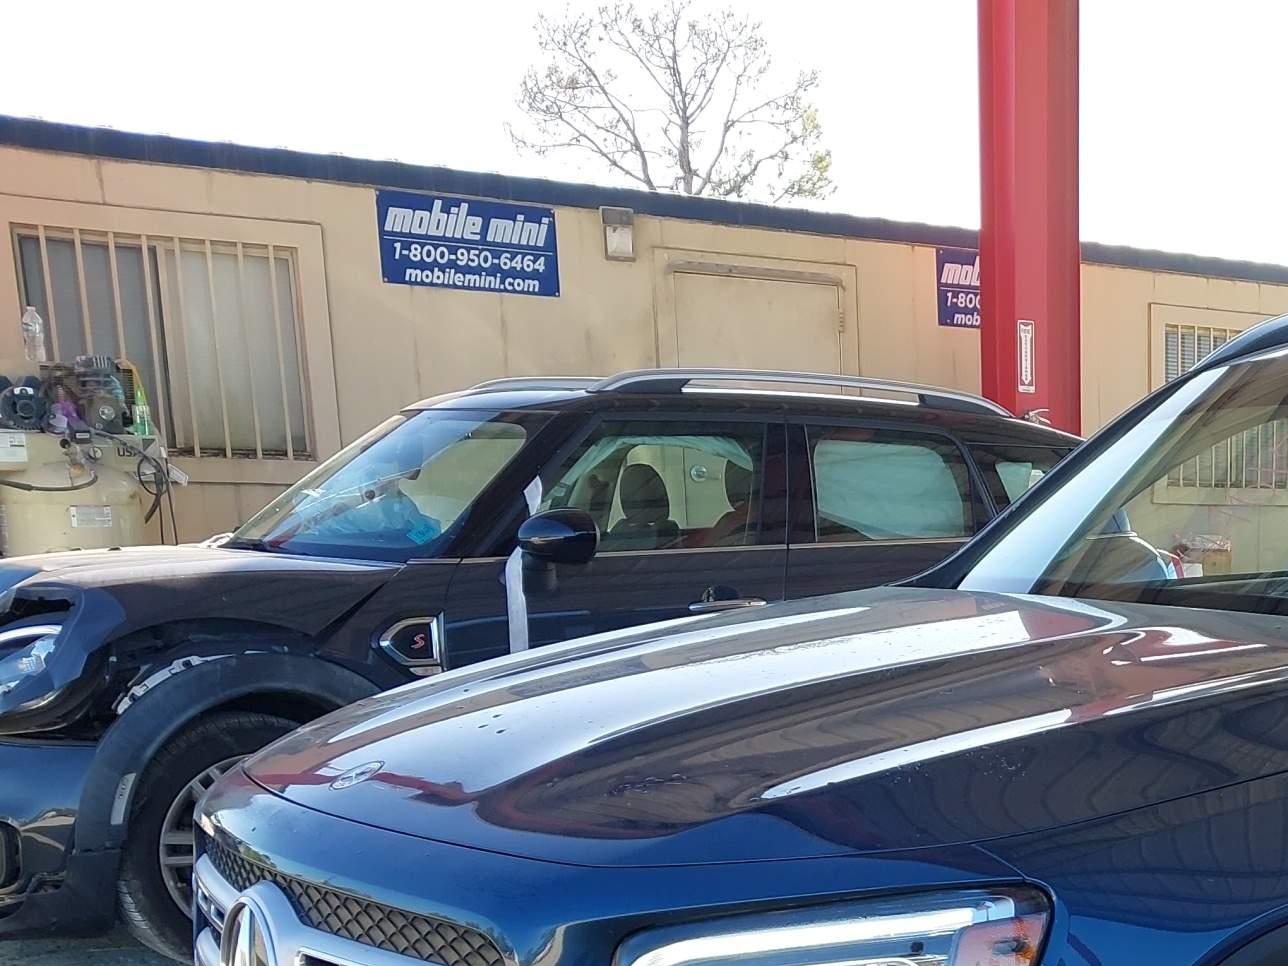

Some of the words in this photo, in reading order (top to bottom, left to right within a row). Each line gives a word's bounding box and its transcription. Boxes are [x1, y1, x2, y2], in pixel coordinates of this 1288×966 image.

[384, 200, 483, 240] mobile
[486, 215, 550, 247] mini
[393, 242, 545, 272] 1-800-950-6464
[405, 267, 540, 292] mobilemini.com
